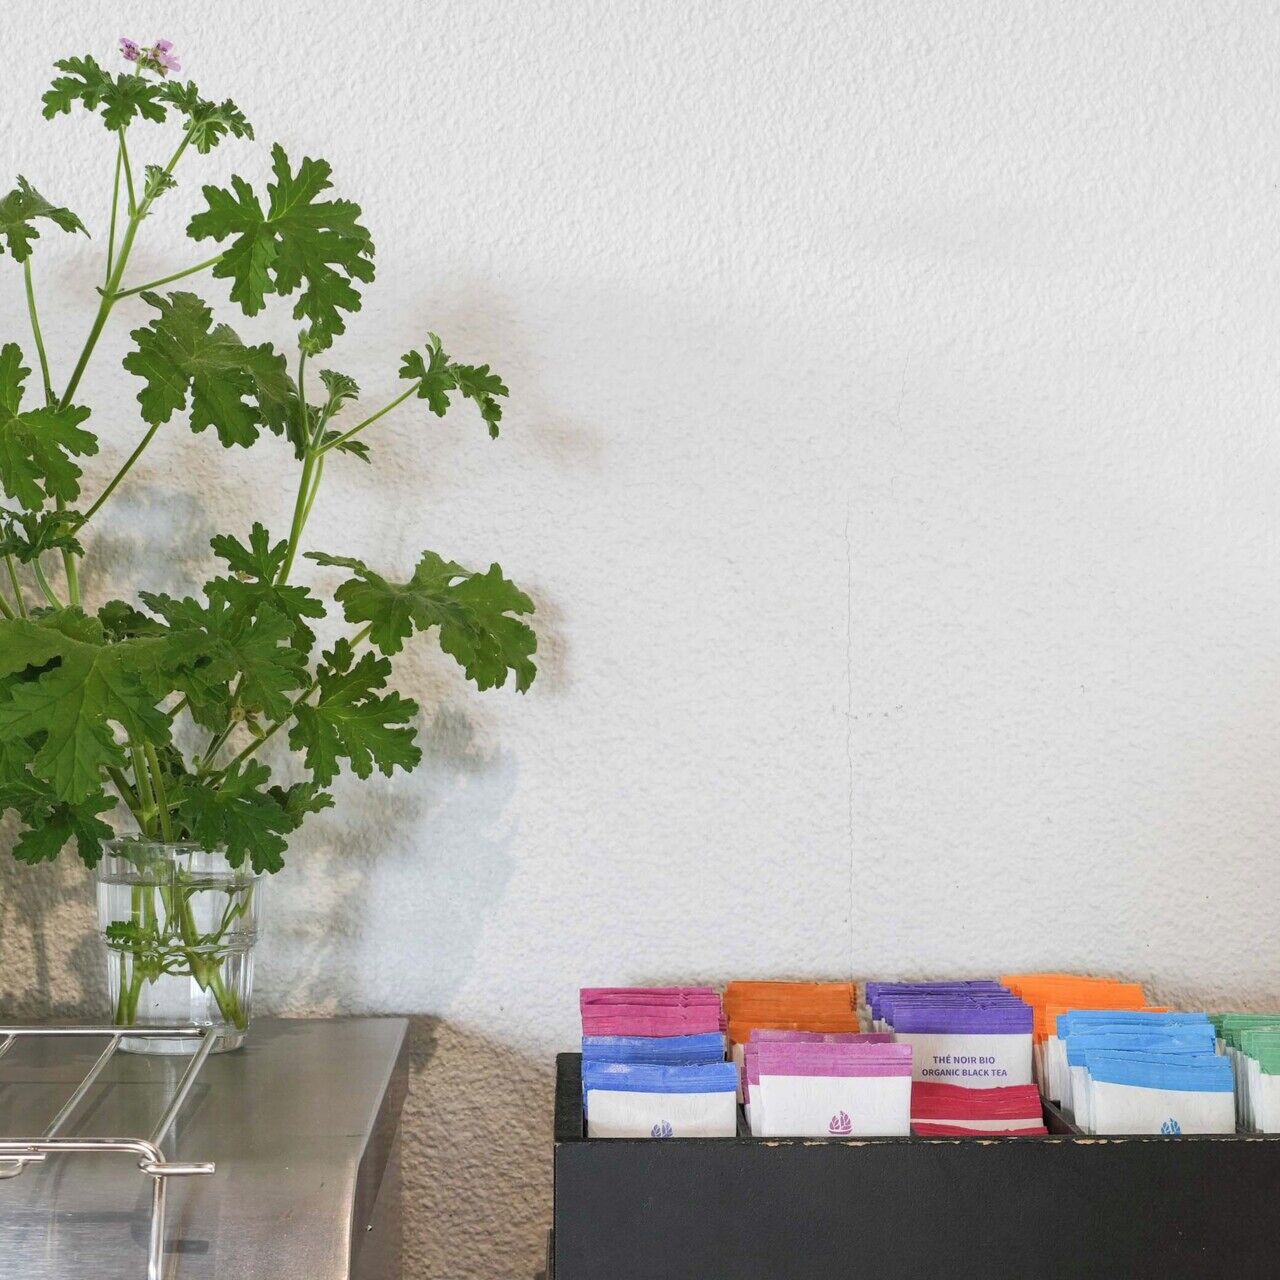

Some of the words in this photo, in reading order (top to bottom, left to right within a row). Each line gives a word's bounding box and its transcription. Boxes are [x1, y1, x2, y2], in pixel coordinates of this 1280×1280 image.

[933, 1054, 951, 1065] THÉ
[953, 1056, 977, 1065] NOIR
[978, 1056, 996, 1065] BIO
[921, 1068, 960, 1077] ORGANIC
[961, 1069, 990, 1077] BLACK
[990, 1069, 1008, 1077] TEA
